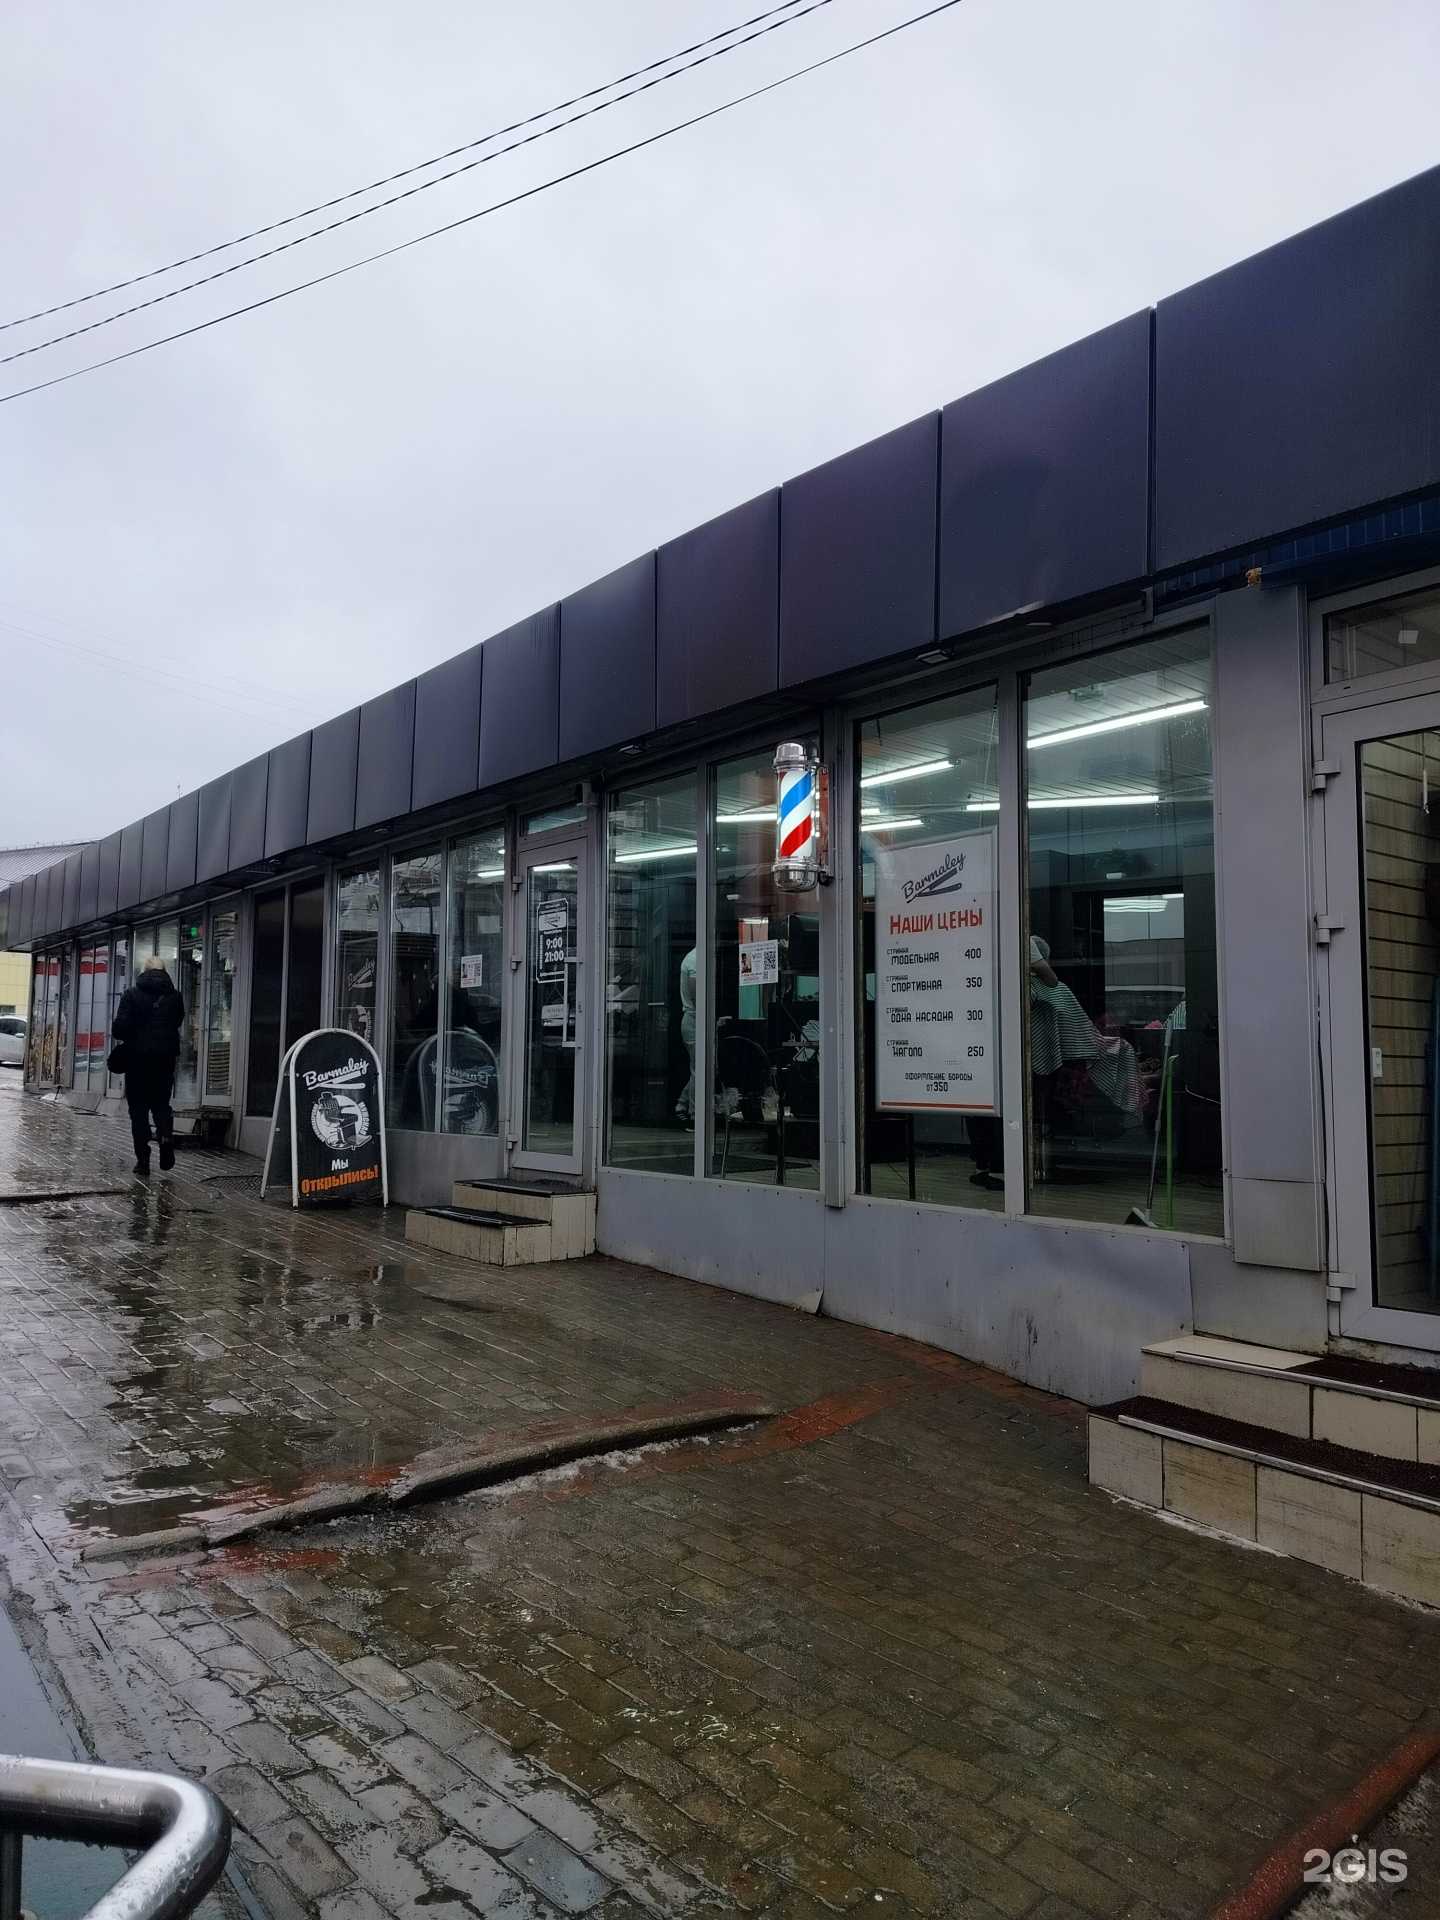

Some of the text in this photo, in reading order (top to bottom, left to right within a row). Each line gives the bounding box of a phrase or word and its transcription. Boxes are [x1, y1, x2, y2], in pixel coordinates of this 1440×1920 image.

[901, 852, 966, 899] Barmaley
[890, 908, 983, 935] НАШИ ЦЕНЫ
[546, 937, 563, 949] 9:00
[544, 950, 564, 963] 21:00
[891, 952, 940, 965] МОДЕЛЬНАЯ
[964, 948, 982, 960] 400
[891, 980, 942, 993] СПОРТИВНАЯ
[966, 977, 983, 988] 350
[891, 1012, 912, 1023] ОДНА
[967, 1010, 983, 1021] 300
[967, 1046, 984, 1057] 250
[302, 1057, 370, 1087] Barmaley
